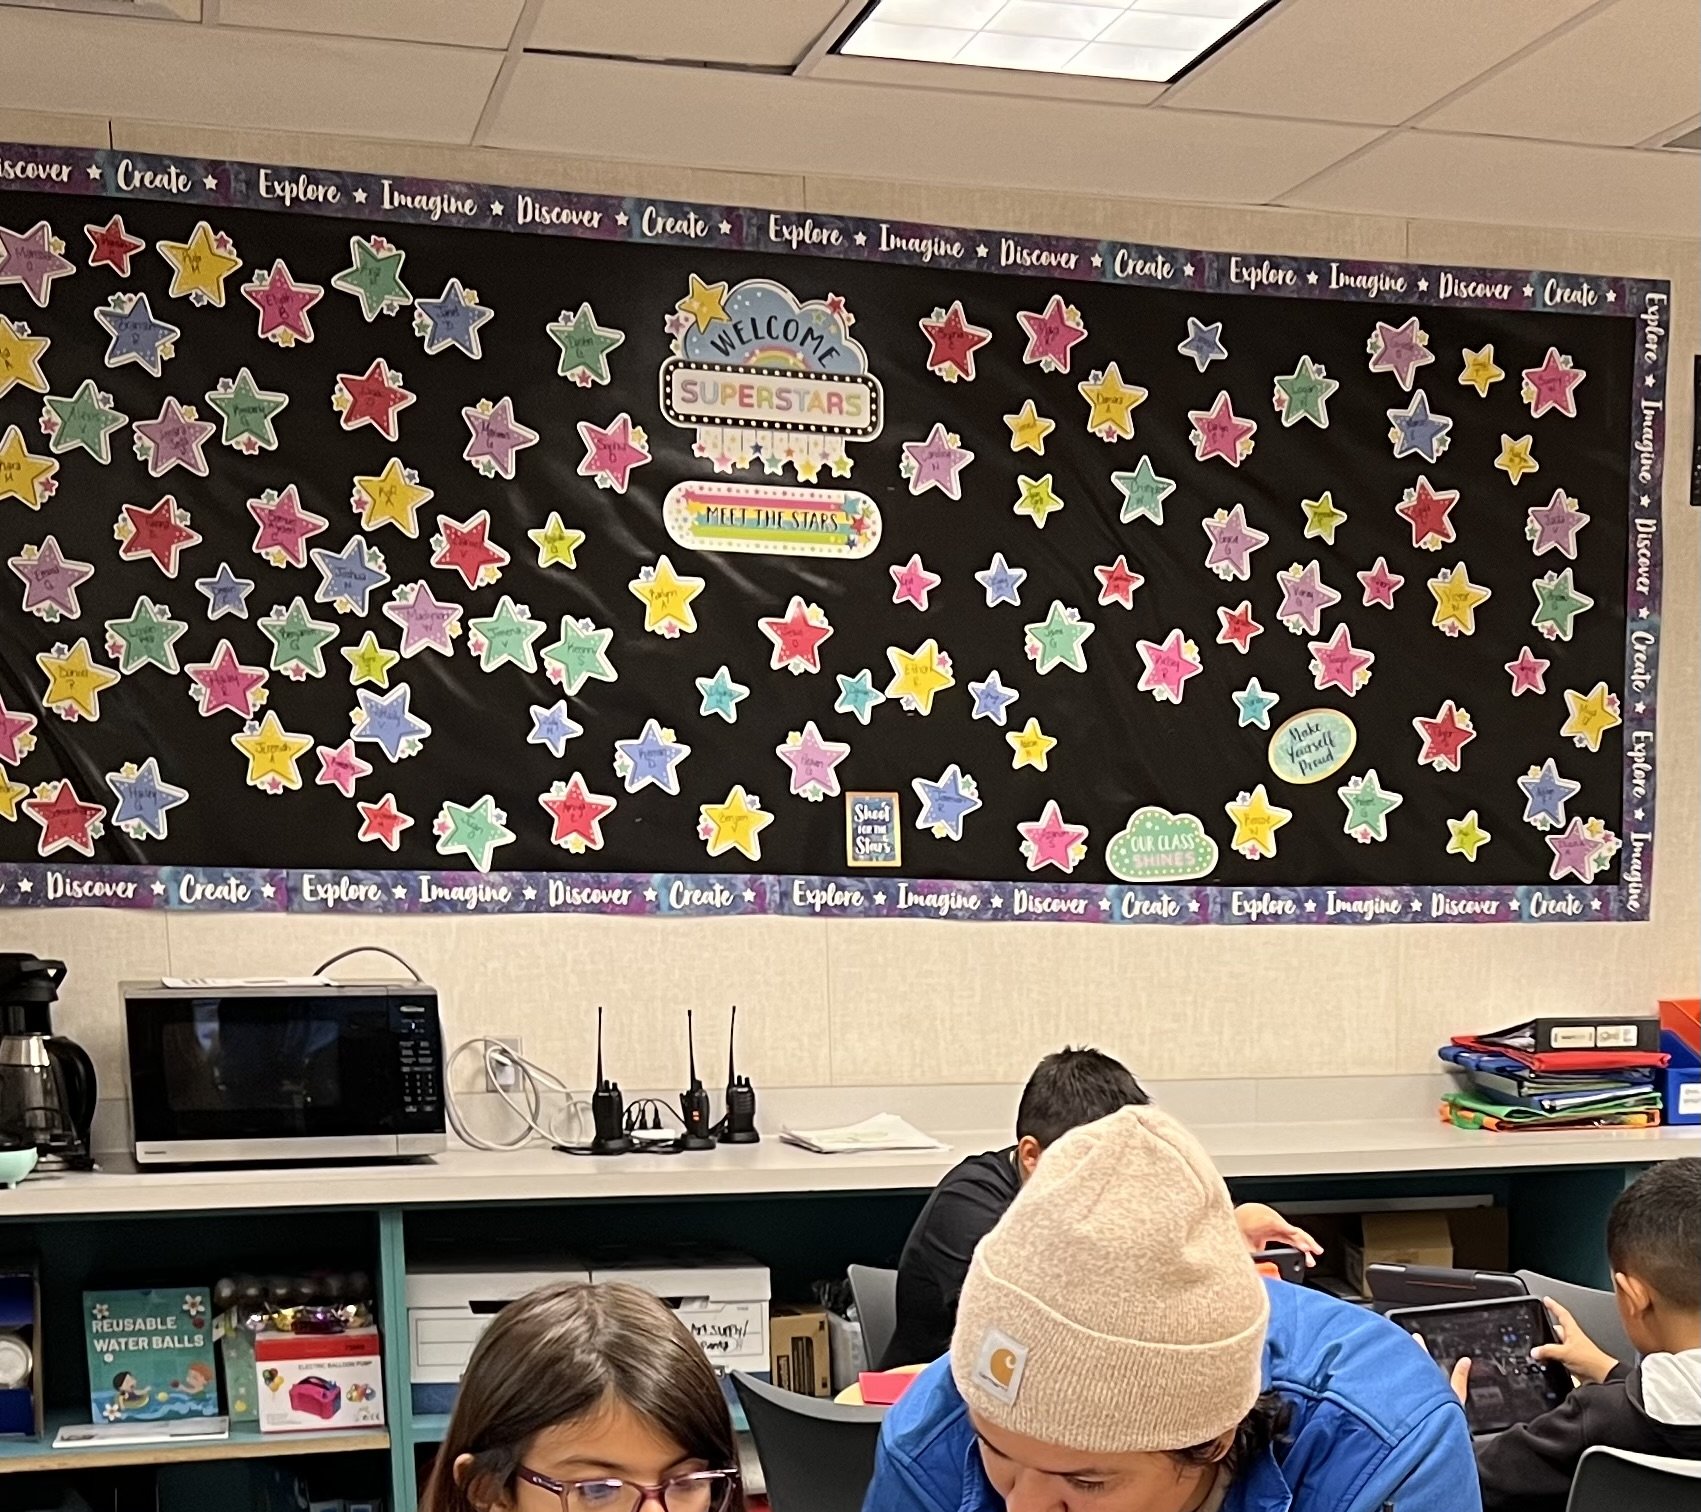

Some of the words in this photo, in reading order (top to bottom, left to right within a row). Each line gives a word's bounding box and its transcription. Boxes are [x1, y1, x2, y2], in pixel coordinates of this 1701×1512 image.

[116, 159, 192, 193] Create
[258, 169, 341, 207] Explore
[380, 180, 477, 220] Imagine
[516, 195, 603, 229] Discover
[641, 206, 710, 238] Create
[768, 214, 844, 251] Explore
[878, 224, 965, 263] Imagine
[1000, 238, 1080, 271] Discover
[1113, 247, 1175, 280] Create
[1229, 256, 1298, 291] Explore
[1328, 262, 1408, 298] Imagine
[1438, 271, 1513, 301] Discover
[1543, 278, 1599, 308] Create
[710, 315, 841, 368] WELCOME
[1643, 291, 1668, 365] Explore
[680, 379, 862, 417] SUPERSTARS
[1632, 396, 1664, 486] Imagine
[706, 506, 746, 526] MEET
[756, 508, 786, 527] THE
[791, 511, 839, 530] STARS
[1633, 518, 1658, 597] Discover
[1630, 629, 1655, 694] Create
[1286, 730, 1336, 764] Yourself
[1288, 722, 1321, 742] Make
[1299, 747, 1334, 776] Proud
[1626, 729, 1653, 801] Explore
[853, 801, 892, 822] Shoot
[855, 834, 891, 855] Stars
[1130, 835, 1156, 852] OUR
[1158, 832, 1195, 851] CLASS
[1132, 851, 1196, 869] SHINES
[1623, 830, 1652, 913] Imagine
[45, 871, 138, 901] Discover
[179, 872, 252, 904] Create
[302, 876, 382, 908] Explore
[418, 875, 512, 909] Imagine
[548, 880, 632, 908] Discover
[670, 880, 734, 909] Create
[792, 880, 864, 911] Explore
[897, 882, 981, 919] Imagine
[1013, 889, 1088, 917] Discover
[1120, 892, 1180, 918] Create
[1231, 891, 1298, 921] Explore
[1325, 891, 1402, 921] Imagine
[1430, 891, 1500, 918] Discover
[1530, 891, 1584, 916] Create
[92, 1316, 177, 1334] REUSABLE
[94, 1336, 149, 1352] WATER
[151, 1334, 204, 1350] BALLS
